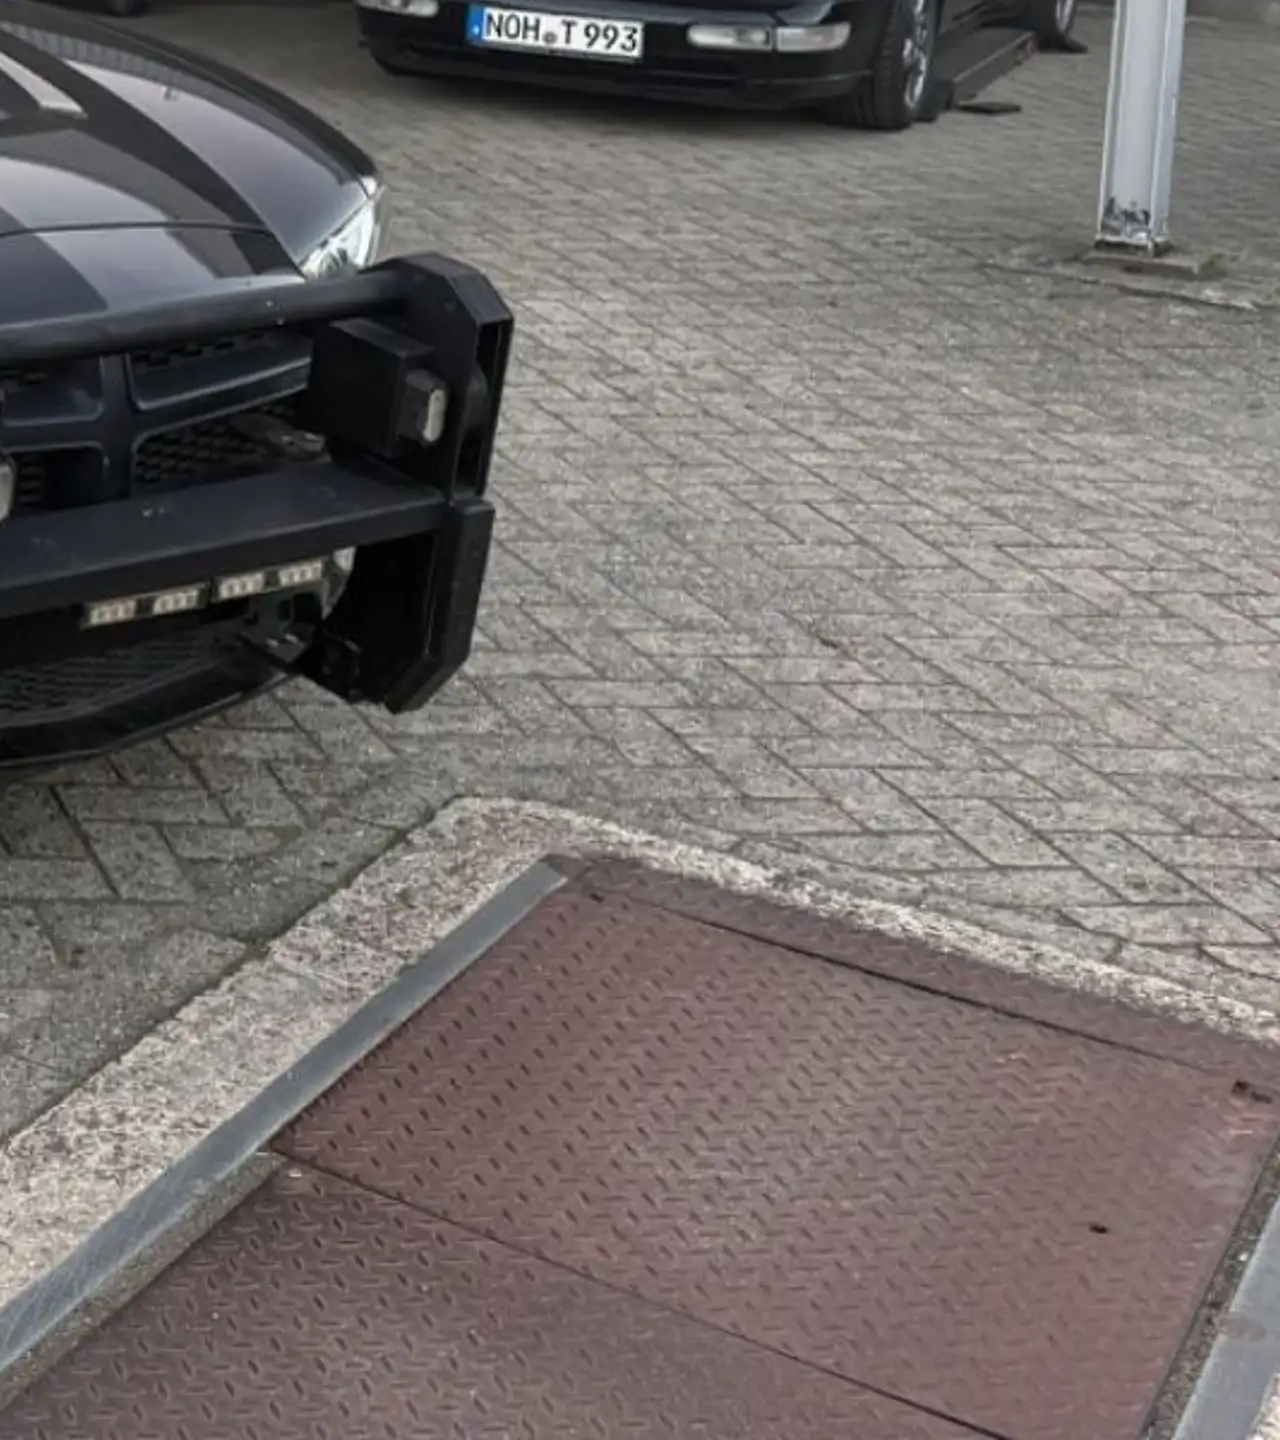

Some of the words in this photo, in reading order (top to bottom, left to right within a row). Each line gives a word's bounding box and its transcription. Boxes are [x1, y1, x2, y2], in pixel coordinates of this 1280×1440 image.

[486, 13, 540, 41] NOH
[561, 19, 578, 45] T
[584, 22, 639, 52] 993
